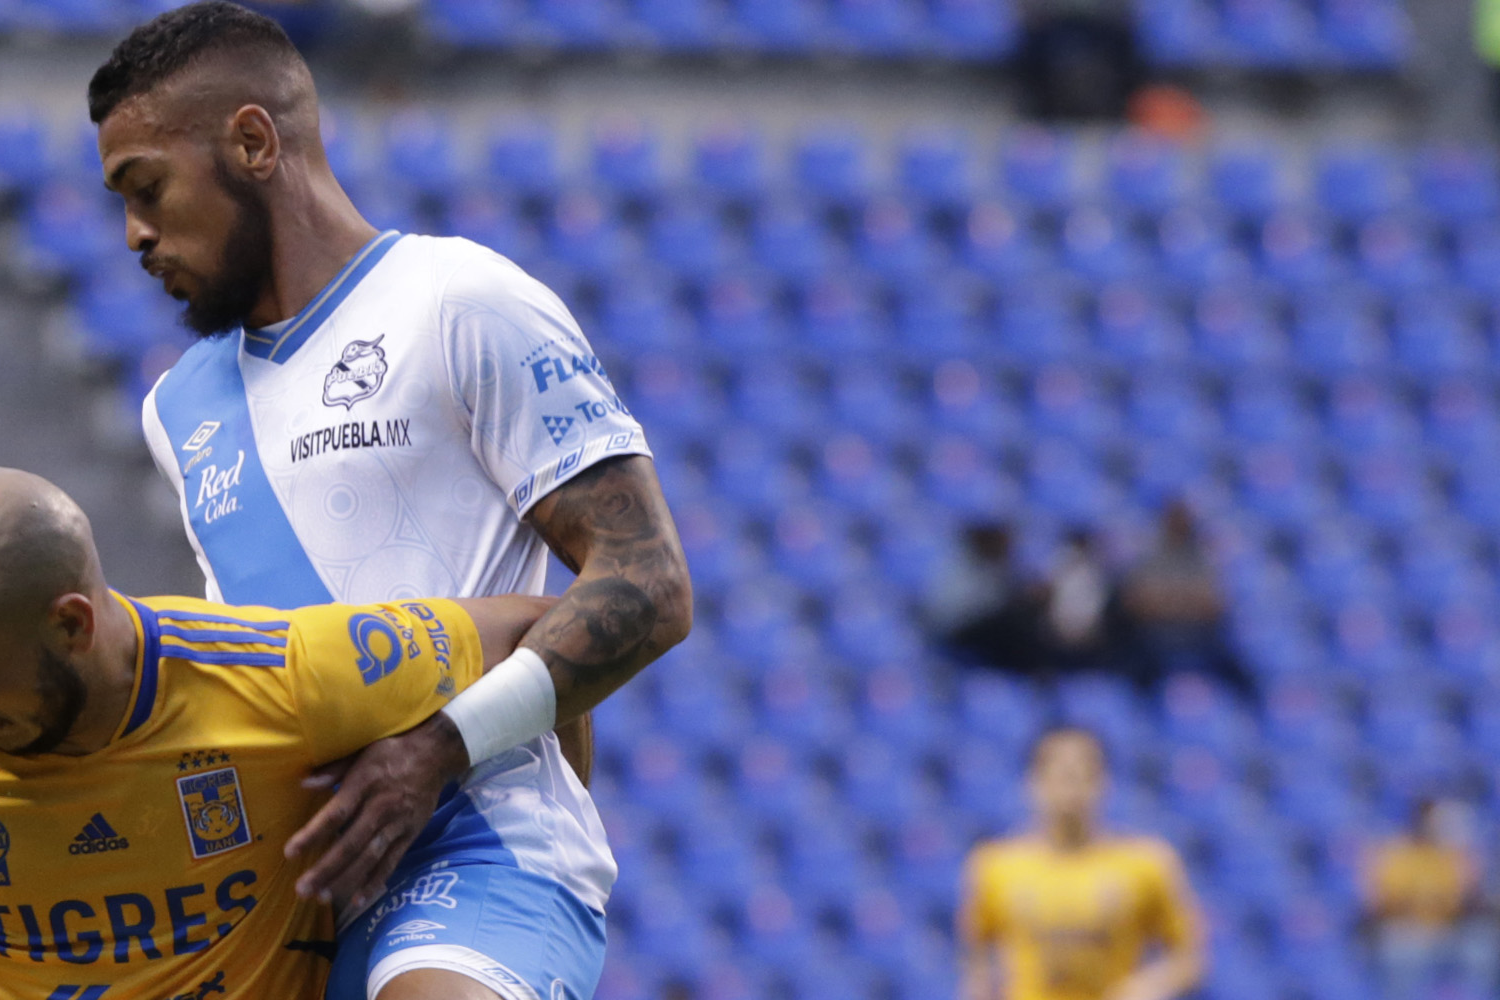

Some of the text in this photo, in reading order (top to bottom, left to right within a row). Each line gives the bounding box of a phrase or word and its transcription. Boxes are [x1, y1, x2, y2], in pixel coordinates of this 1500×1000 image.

[290, 419, 411, 463] VISITPUEBLA.MX
[195, 450, 244, 508] Red
[204, 491, 238, 524] Cola
[68, 837, 129, 855] adidas
[388, 933, 436, 946] umbro
